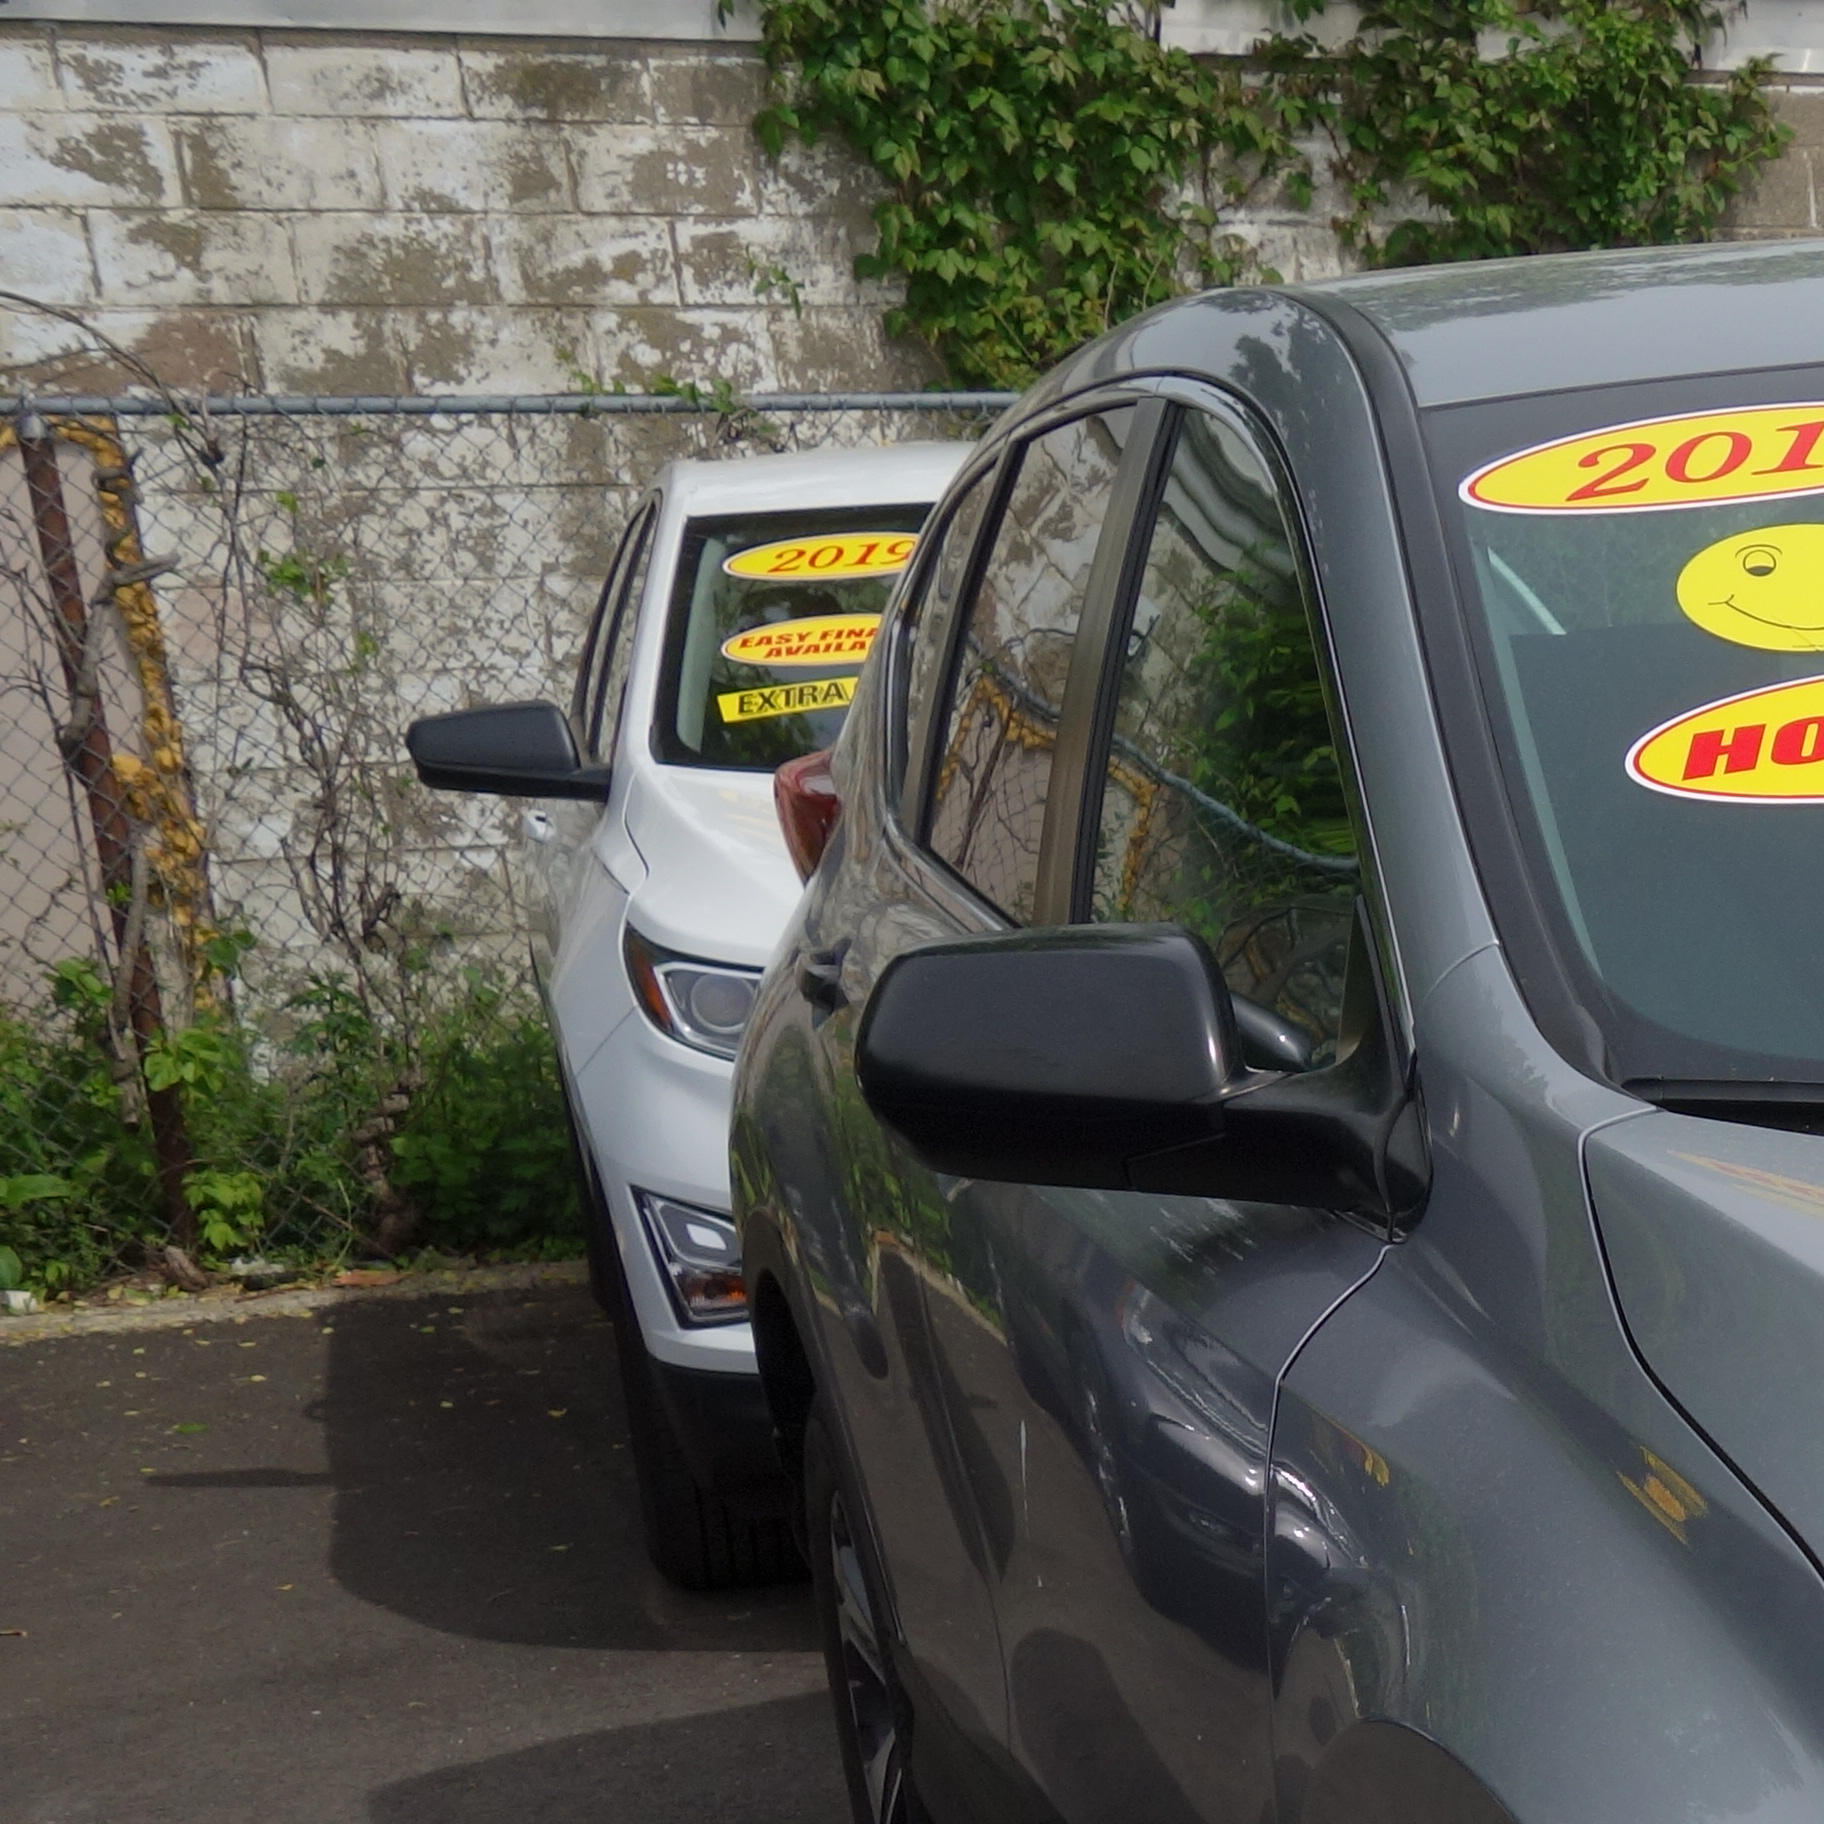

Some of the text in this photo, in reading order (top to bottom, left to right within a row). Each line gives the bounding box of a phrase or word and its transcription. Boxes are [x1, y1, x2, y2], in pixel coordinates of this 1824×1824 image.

[766, 540, 915, 573] 2019
[738, 631, 812, 648] EASY
[764, 640, 867, 658] AVAILA
[738, 682, 848, 715] EXTRA
